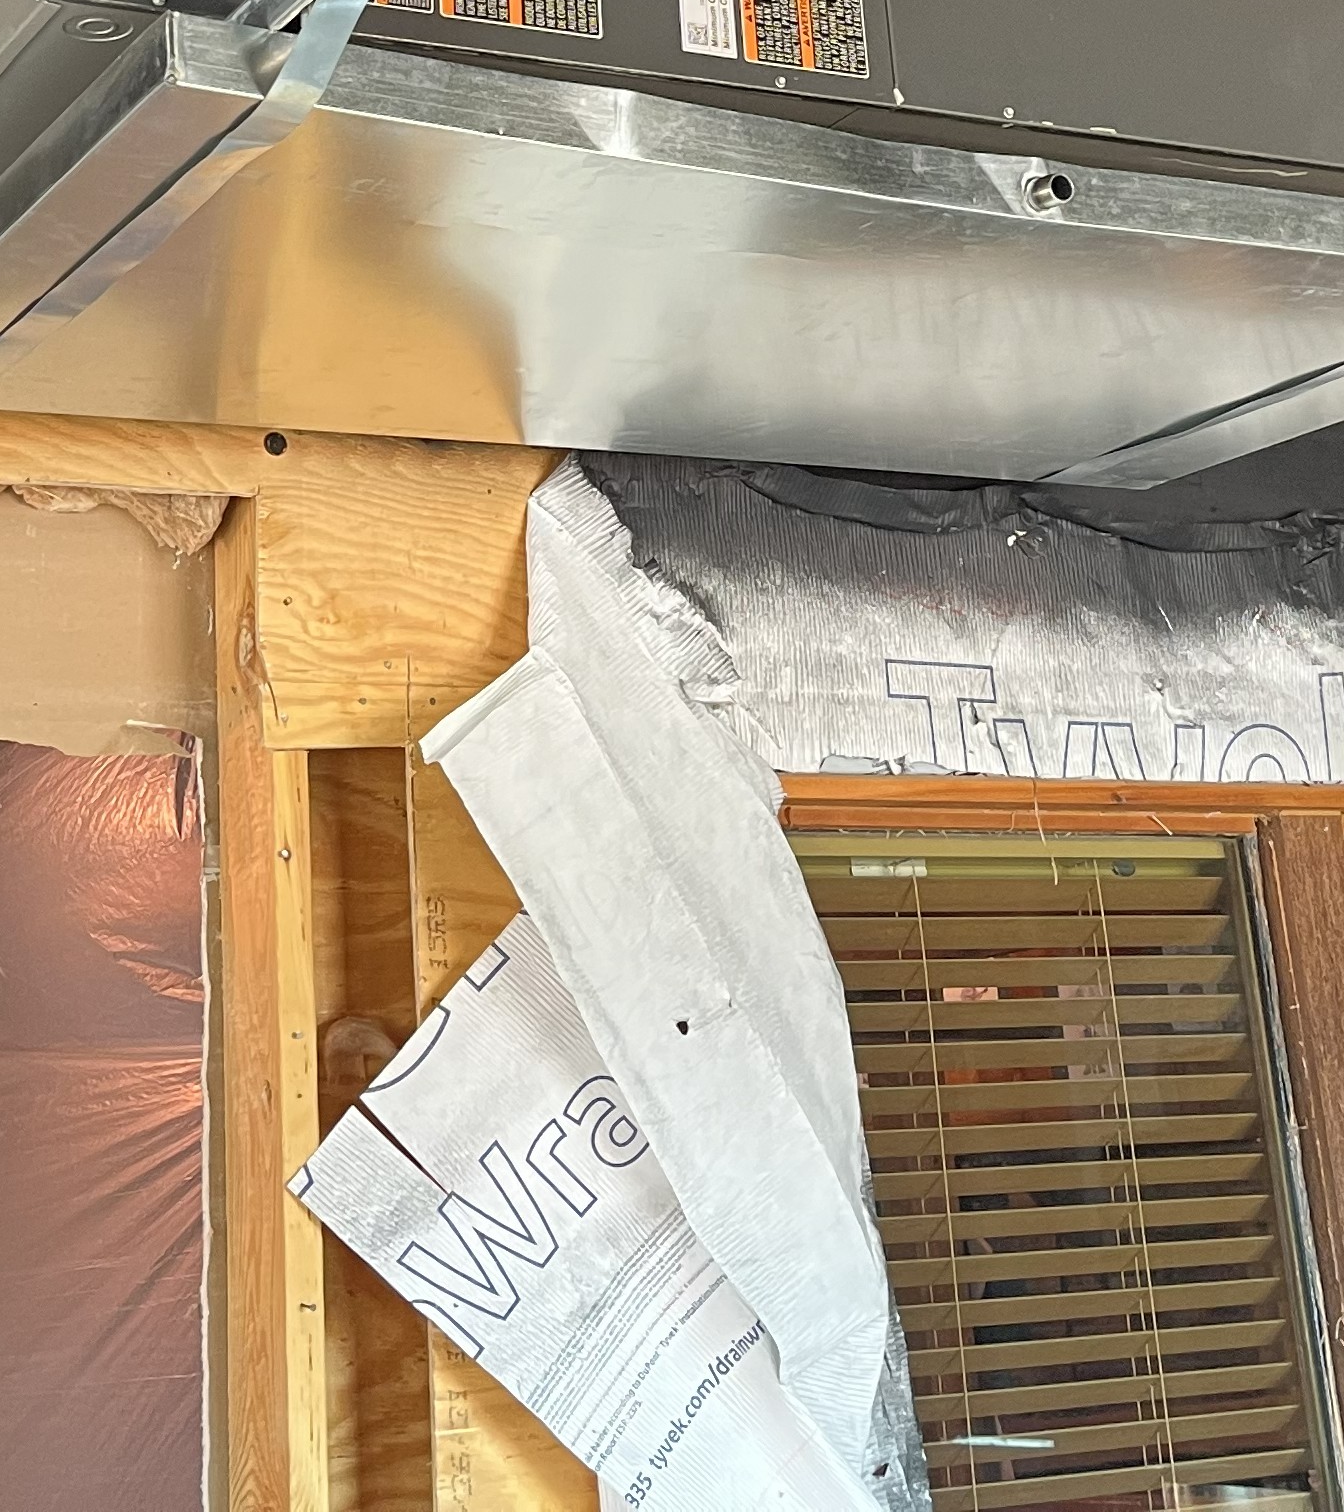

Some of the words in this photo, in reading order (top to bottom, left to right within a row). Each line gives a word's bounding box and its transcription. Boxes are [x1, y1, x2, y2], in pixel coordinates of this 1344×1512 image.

[710, 5, 718, 47] Minimum
[722, 8, 730, 49] Minimum
[757, 26, 765, 37] OF
[759, 40, 767, 59] RISK
[608, 1388, 635, 1428] according
